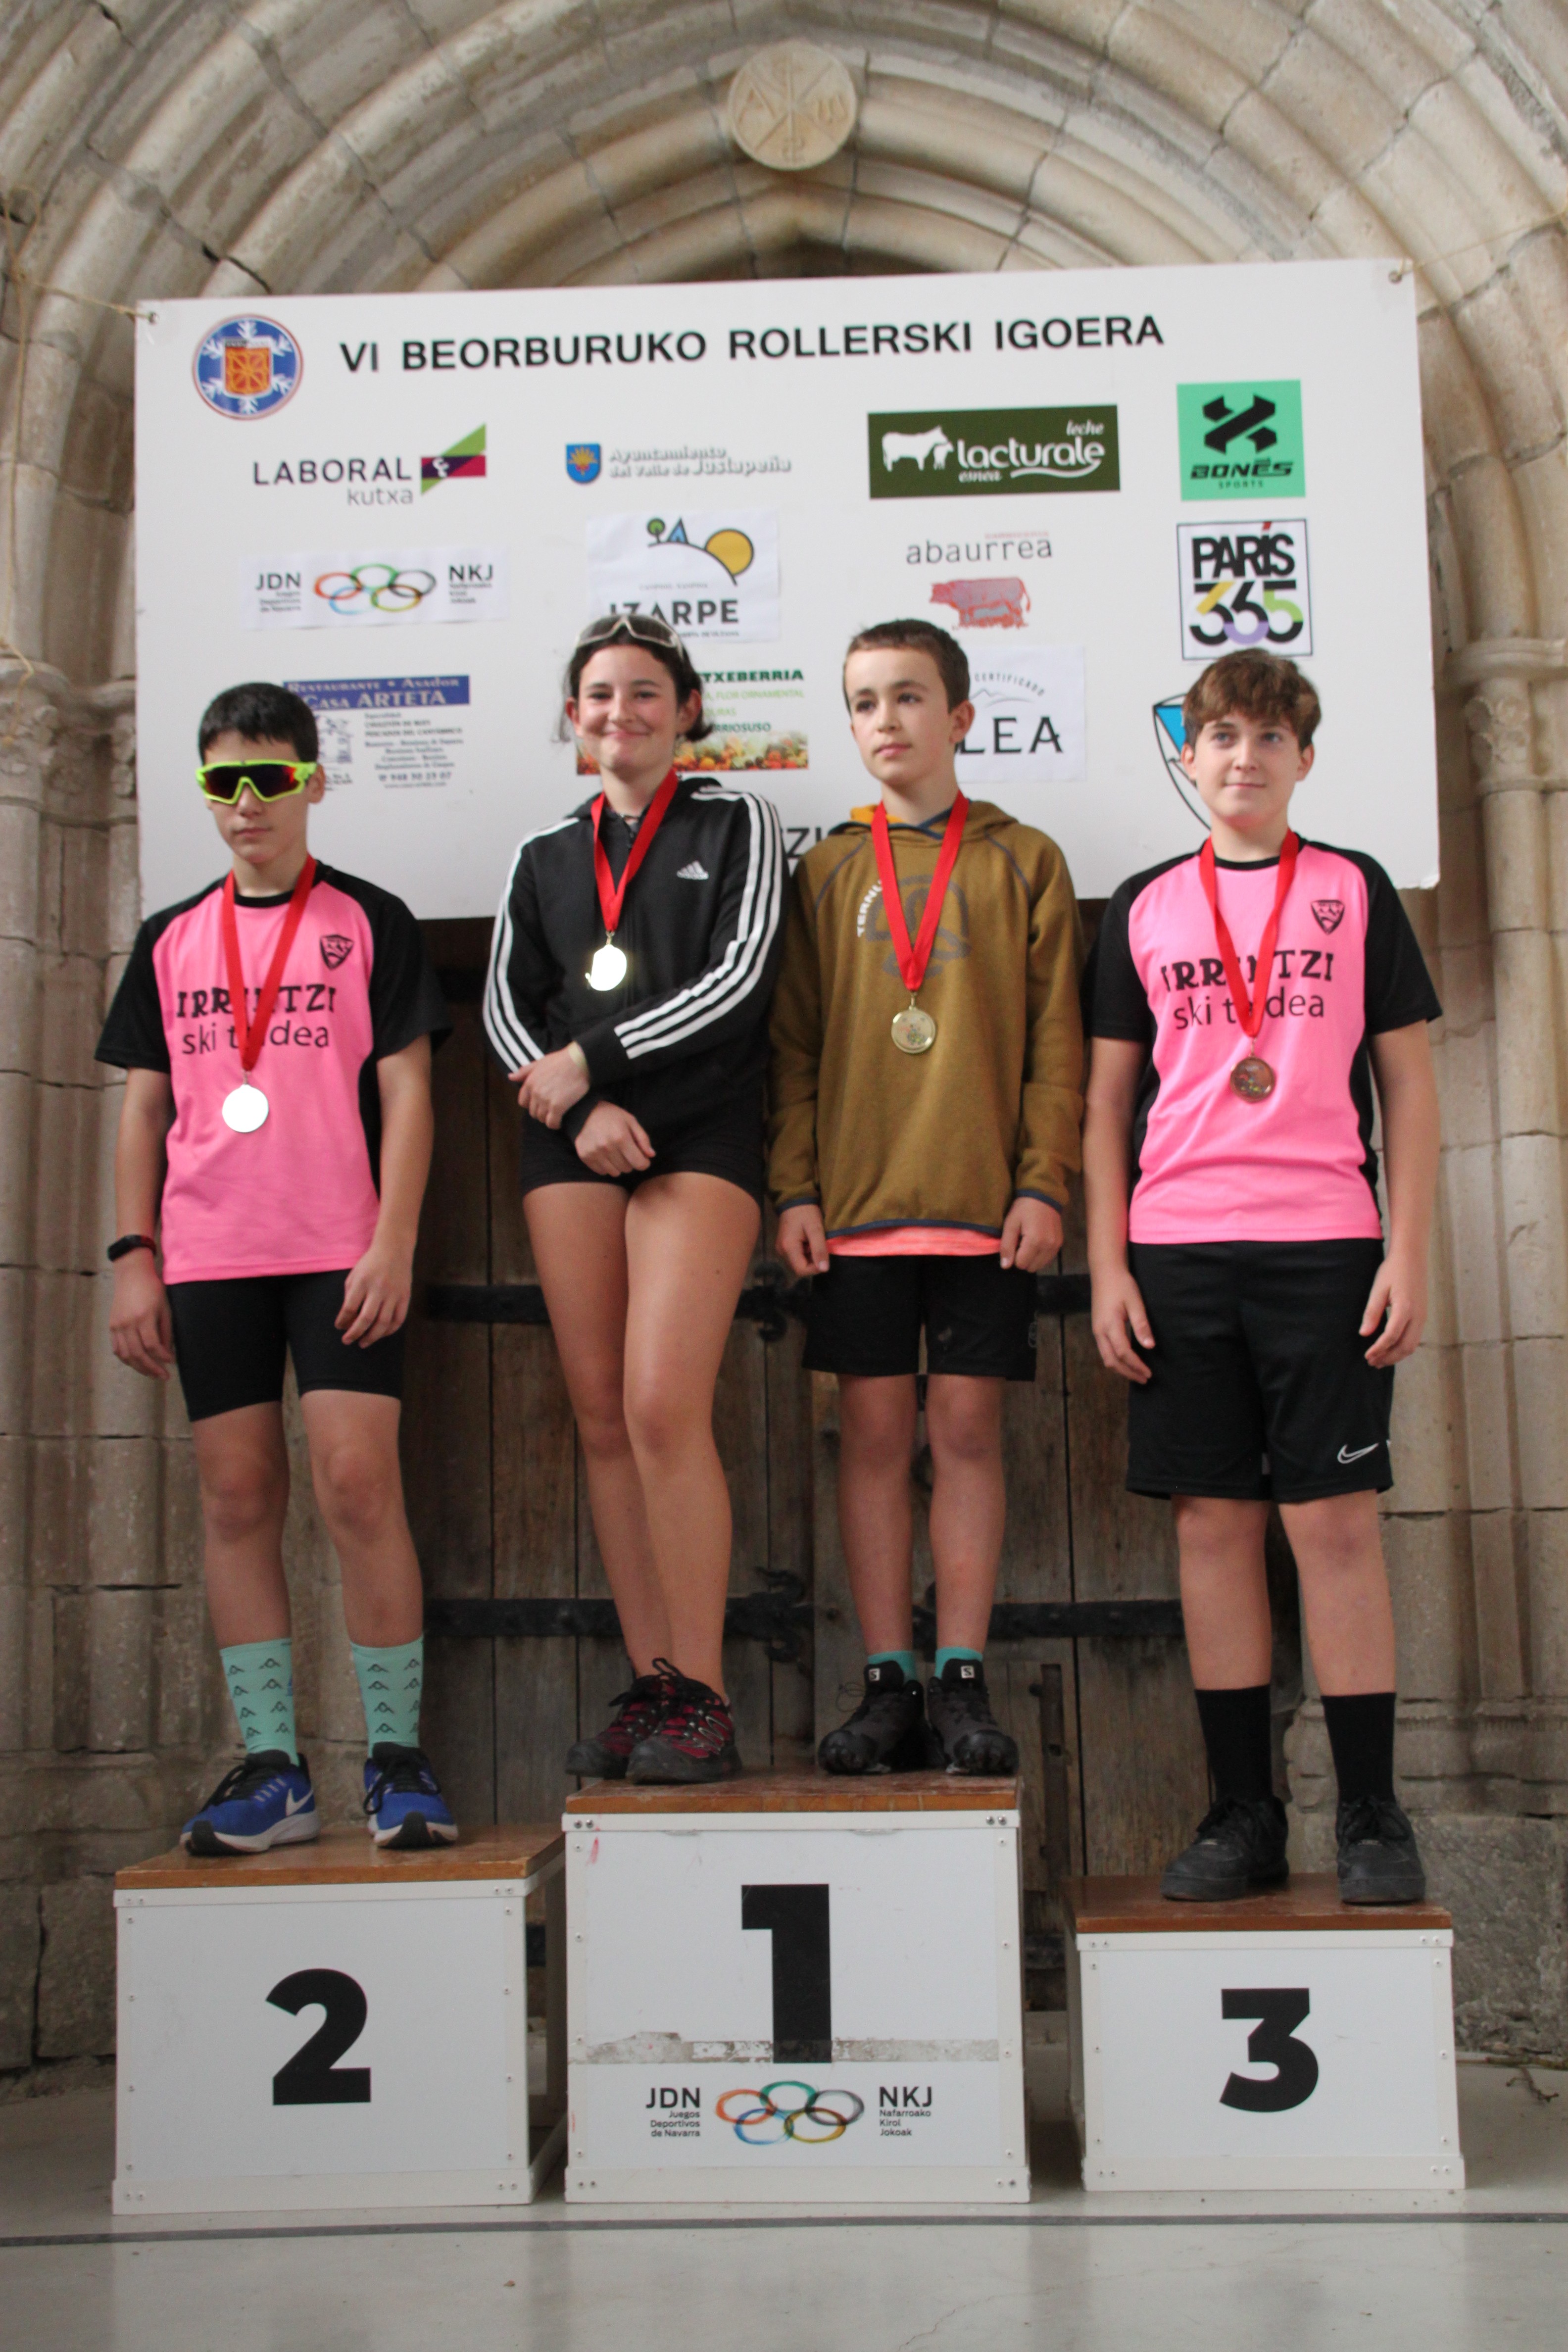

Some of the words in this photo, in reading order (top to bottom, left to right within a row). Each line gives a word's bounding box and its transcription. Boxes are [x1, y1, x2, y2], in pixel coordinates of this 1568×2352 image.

[340, 342, 379, 372] VI
[402, 331, 706, 371] BEORBURUKO
[729, 321, 972, 359] ROLLERSKI
[995, 315, 1165, 349] IGOERA
[1067, 420, 1104, 436] leche
[609, 445, 727, 464] Ayuntamiento
[957, 437, 1106, 469] lacturale
[253, 456, 412, 486] LABORAL
[347, 488, 413, 506] kutxa
[1218, 480, 1264, 490] SPORTS
[906, 539, 1052, 564] abaurrea
[1192, 521, 1295, 579] PARÍS
[256, 572, 300, 590] JDN
[449, 564, 493, 581] NKJ
[1189, 580, 1304, 646] 365
[701, 670, 803, 683] TXEBERRIA
[357, 690, 446, 707] ARTETA
[956, 716, 1064, 754] LEA
[1161, 950, 1333, 992] IRRTZI
[177, 984, 337, 1018] IRRTZI
[1174, 996, 1212, 1030] ski
[1223, 986, 1324, 1024] tdea
[182, 1023, 216, 1054] ski
[228, 1020, 329, 1049] tdea
[741, 1884, 832, 2063] 1
[265, 1968, 371, 2106] 2
[1219, 1987, 1319, 2113] 3
[646, 2087, 700, 2108] JDN
[880, 2086, 931, 2107] NKJ
[651, 2120, 700, 2128] Deportivos
[669, 2110, 700, 2119] Juegos
